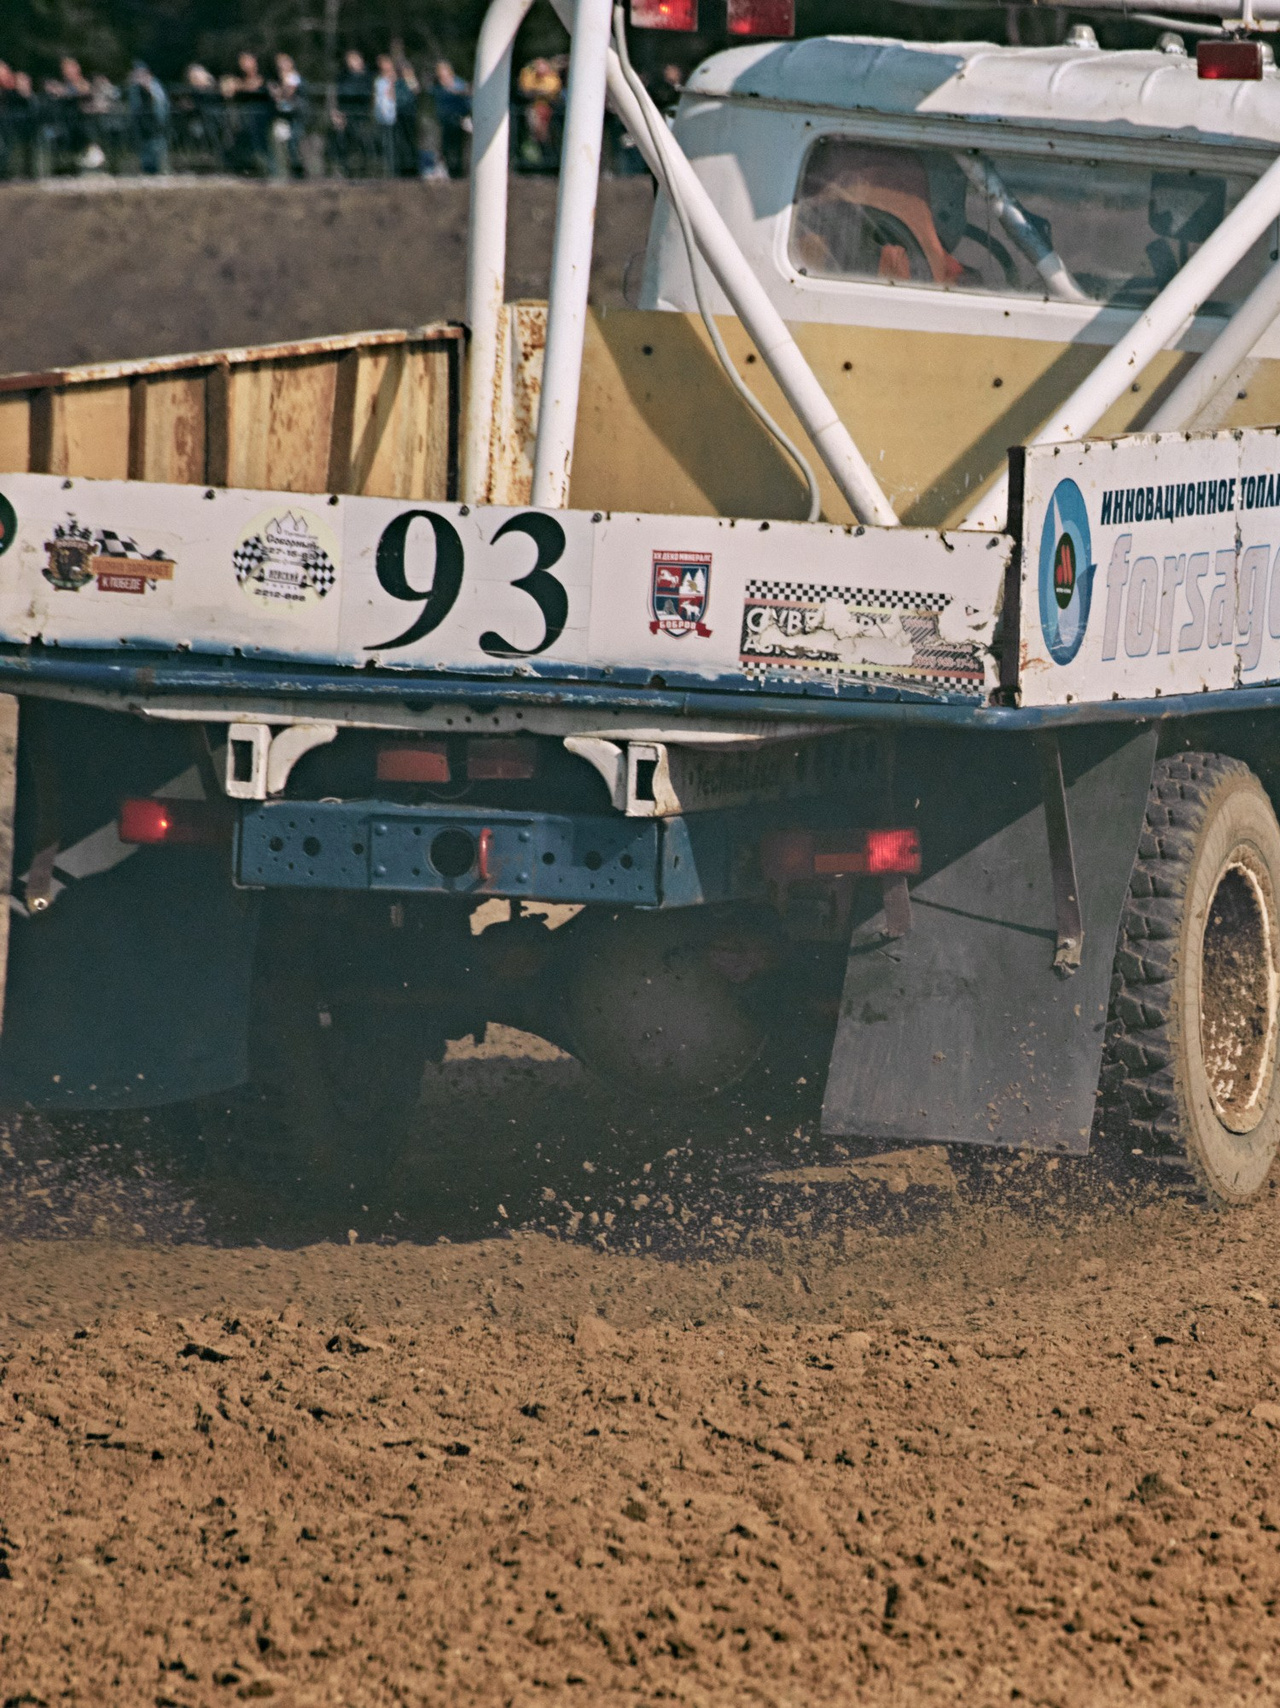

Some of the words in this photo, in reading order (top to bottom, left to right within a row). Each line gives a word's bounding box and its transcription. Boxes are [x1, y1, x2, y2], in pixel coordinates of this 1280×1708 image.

[1100, 478, 1236, 525] ИННОВАЦИОННОЕ
[362, 509, 569, 659] 93
[660, 620, 697, 631] БОБРОВ
